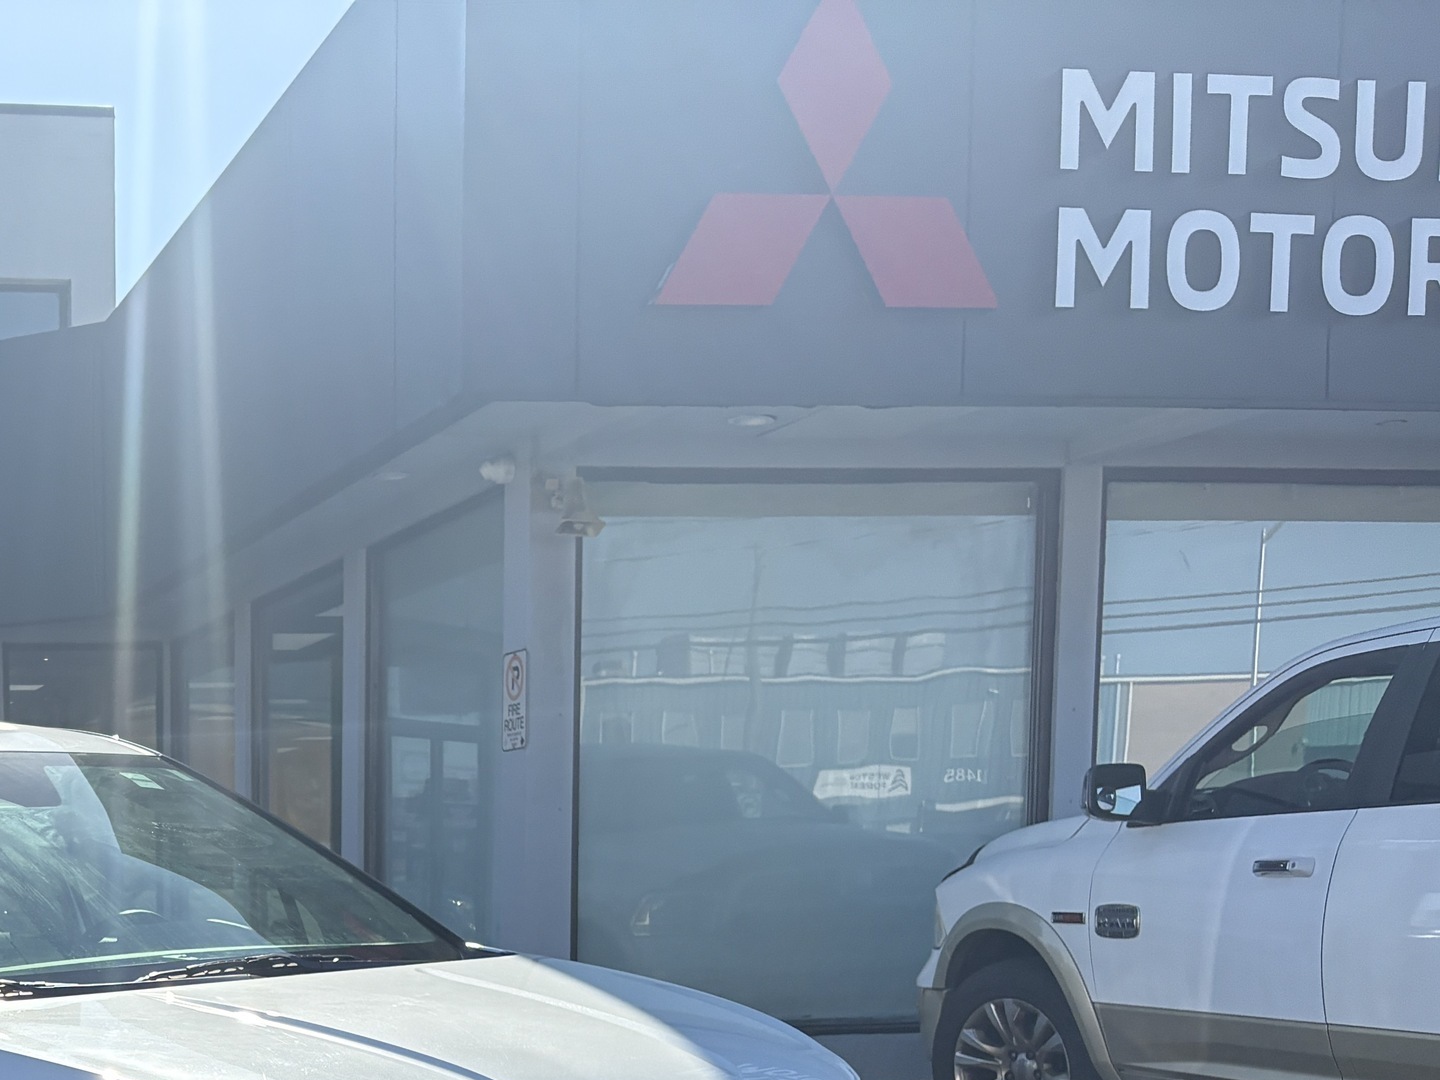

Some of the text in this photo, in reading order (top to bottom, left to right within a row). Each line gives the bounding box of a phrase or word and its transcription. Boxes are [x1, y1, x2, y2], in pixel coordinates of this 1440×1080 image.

[1060, 68, 1440, 181] MITSU
[508, 703, 521, 716] FIRE
[504, 716, 525, 731] ROUTE
